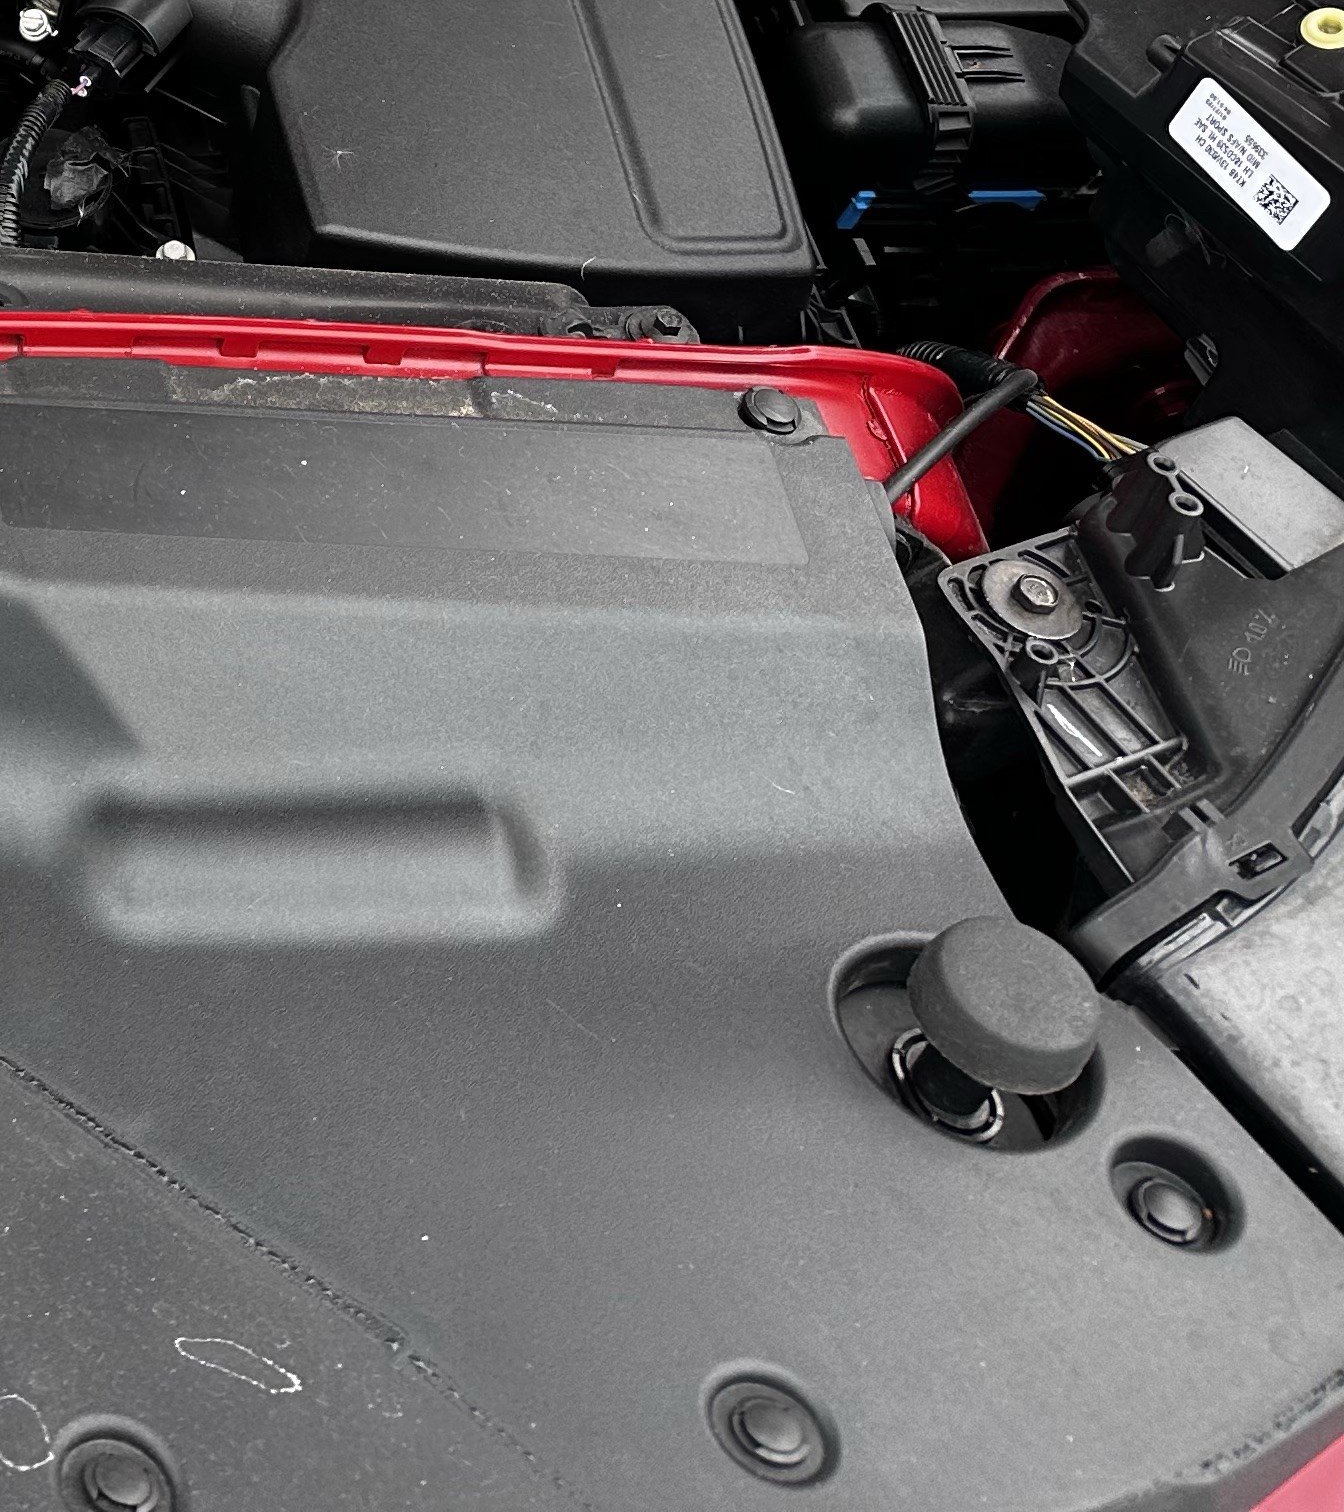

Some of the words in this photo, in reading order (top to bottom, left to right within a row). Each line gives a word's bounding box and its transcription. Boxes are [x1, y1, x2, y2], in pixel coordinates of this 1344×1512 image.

[1193, 117, 1208, 133] SAE
[1206, 113, 1229, 135] SPORT
[1195, 134, 1207, 147] CH
[1208, 131, 1220, 143] HL
[1246, 154, 1261, 169] MID
[1228, 169, 1247, 188] KT4B
[1243, 166, 1255, 179] LH
